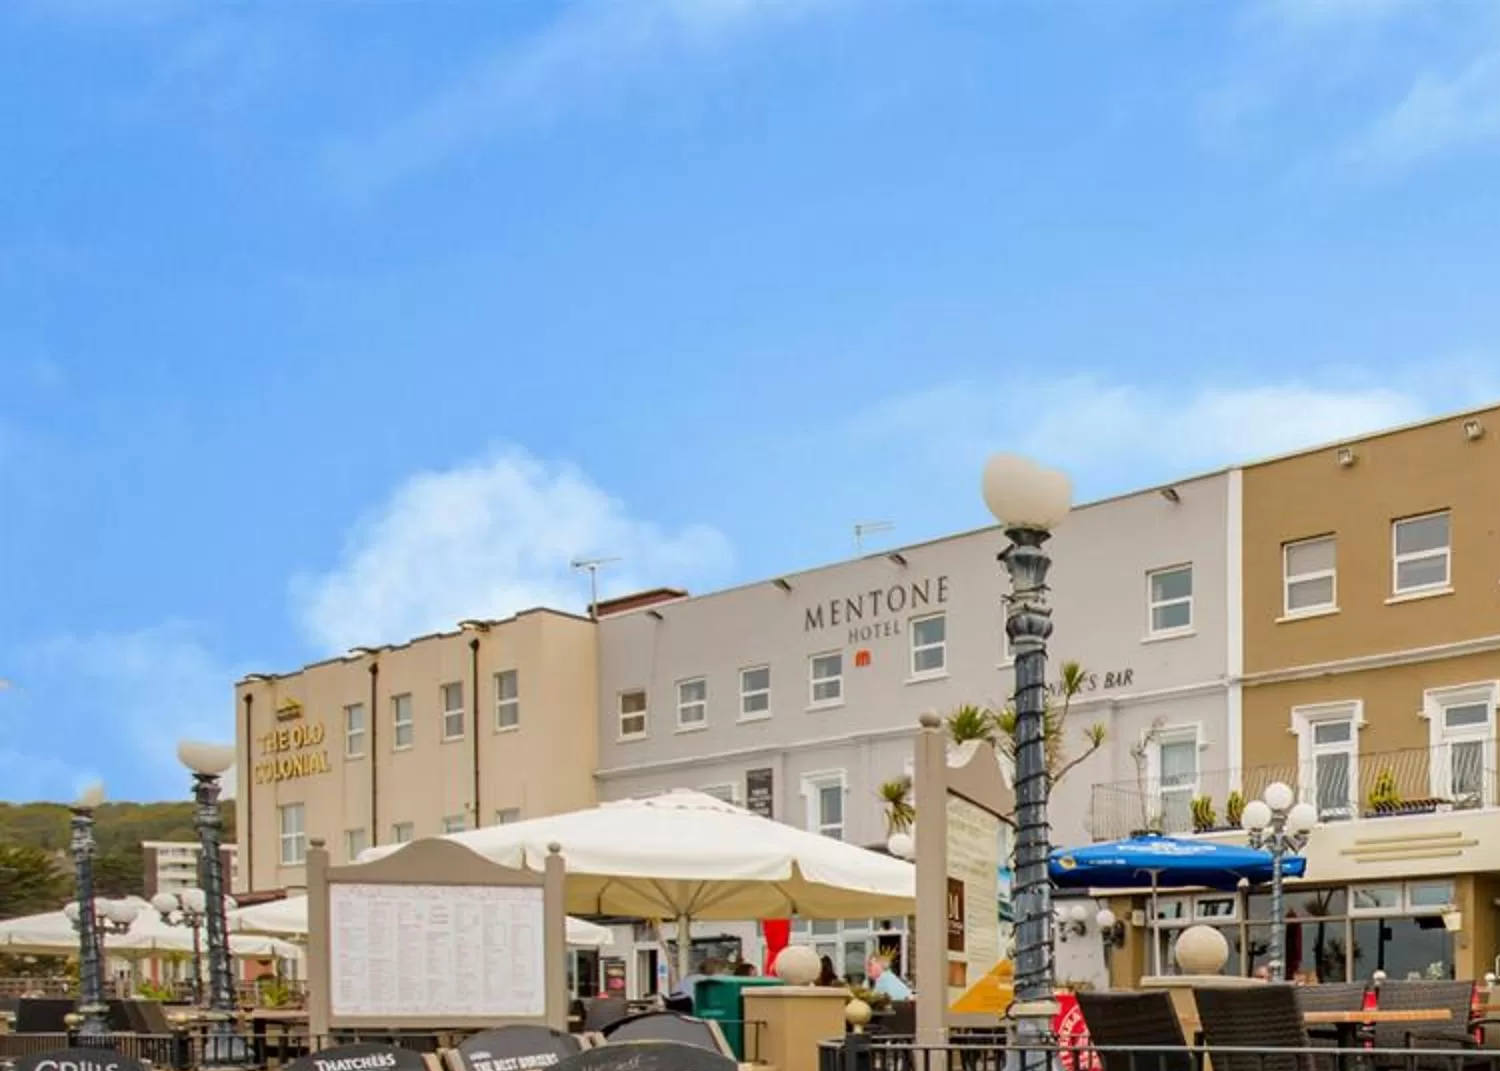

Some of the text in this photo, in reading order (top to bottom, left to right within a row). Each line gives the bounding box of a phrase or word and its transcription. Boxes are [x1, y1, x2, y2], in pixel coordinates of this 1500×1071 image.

[805, 576, 949, 632] MENTONE
[848, 619, 901, 644] HOTEL
[1104, 668, 1134, 689] BAR
[256, 722, 325, 756] THE OLD
[255, 750, 332, 785] COLONIAL
